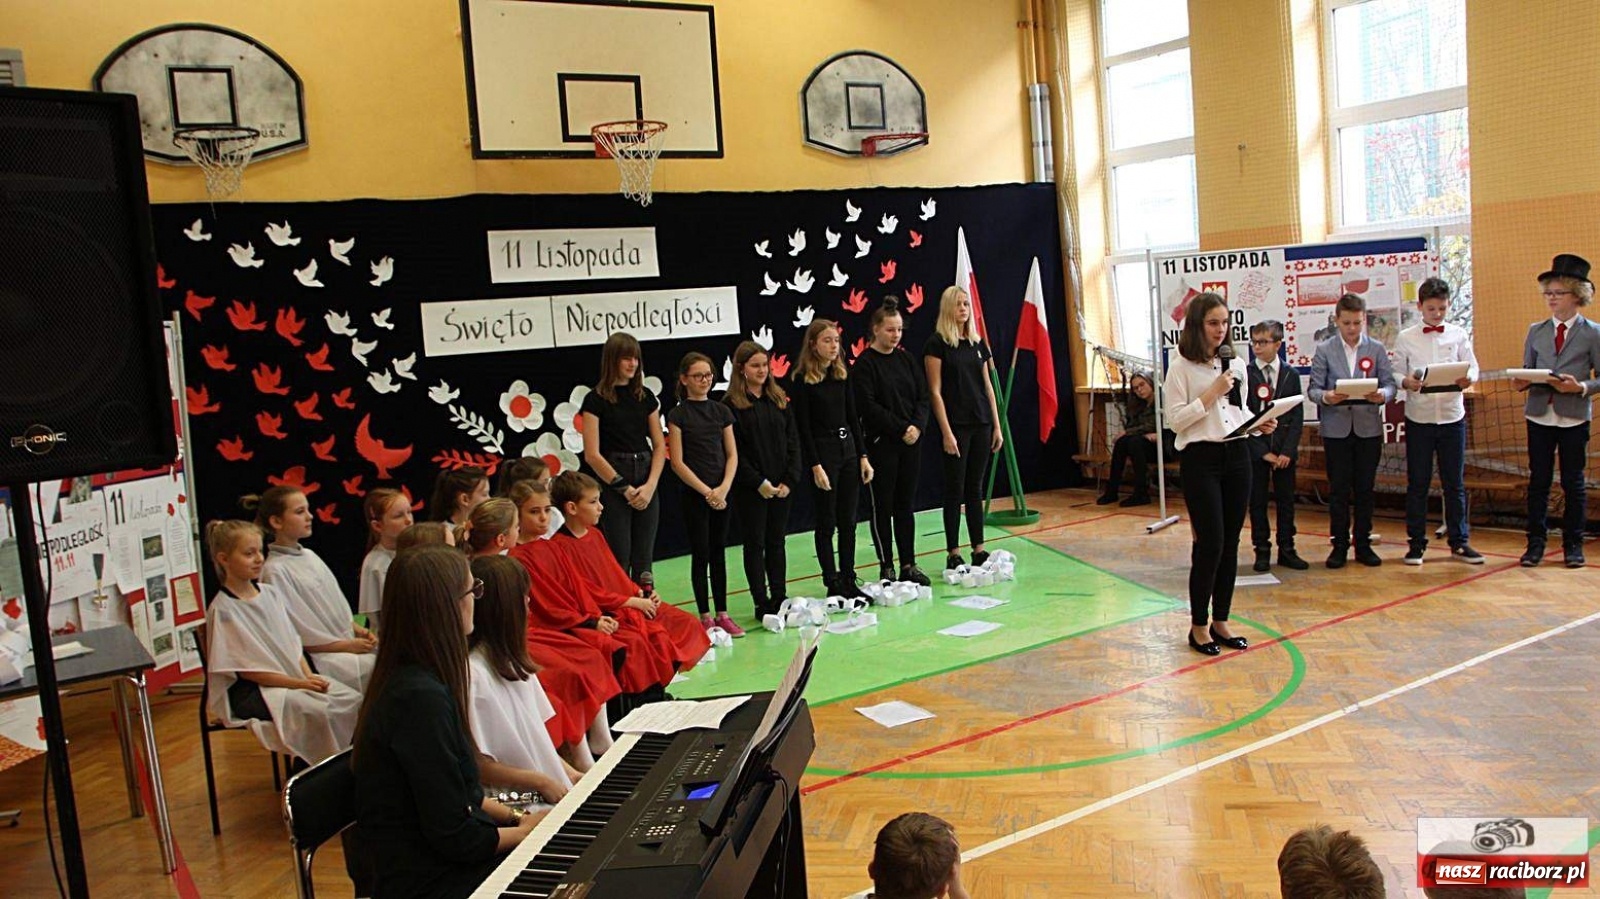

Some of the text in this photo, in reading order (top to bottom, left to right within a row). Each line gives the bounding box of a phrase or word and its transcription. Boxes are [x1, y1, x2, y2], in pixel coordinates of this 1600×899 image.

[502, 238, 641, 276] 11 Listopada
[1163, 251, 1271, 275] 11 LISTOPADA
[440, 307, 533, 344] Święto
[110, 489, 126, 525] 11
